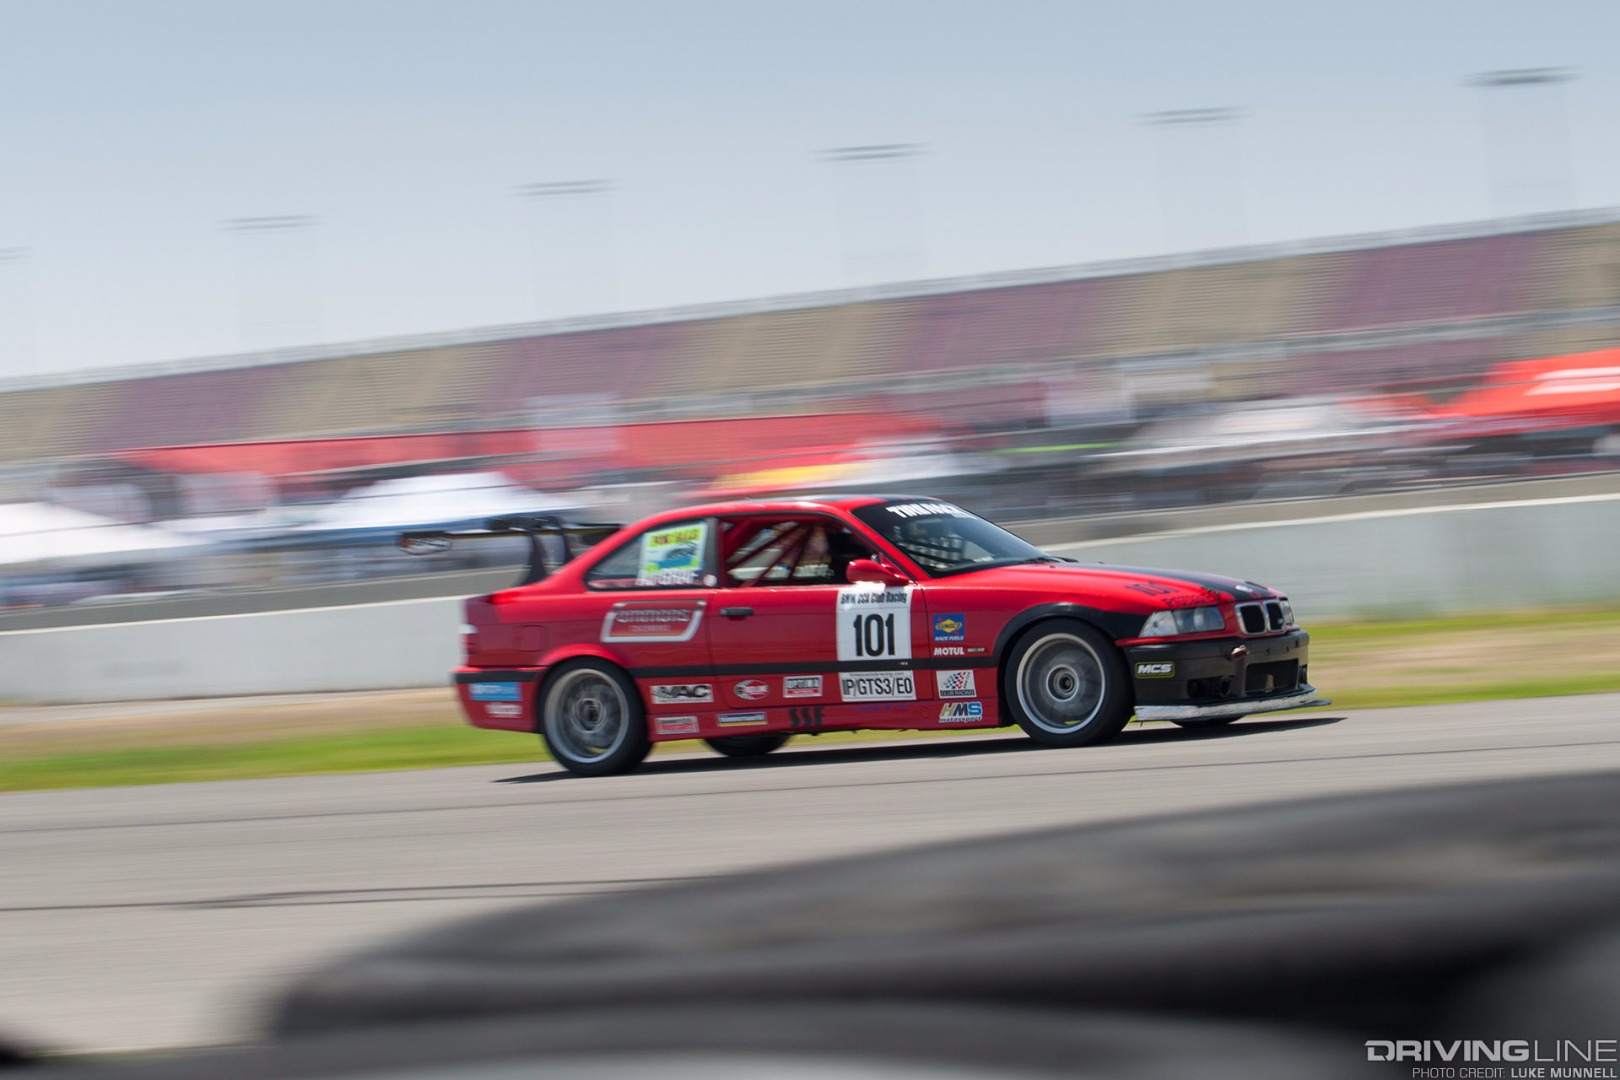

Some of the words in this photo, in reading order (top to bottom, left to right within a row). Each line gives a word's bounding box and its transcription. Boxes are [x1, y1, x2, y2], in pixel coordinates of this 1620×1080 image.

[886, 590, 908, 604] Racing
[853, 613, 895, 657] 101
[934, 647, 965, 656] MOTUL
[1138, 664, 1172, 674] MCS
[940, 702, 983, 717] HMS
